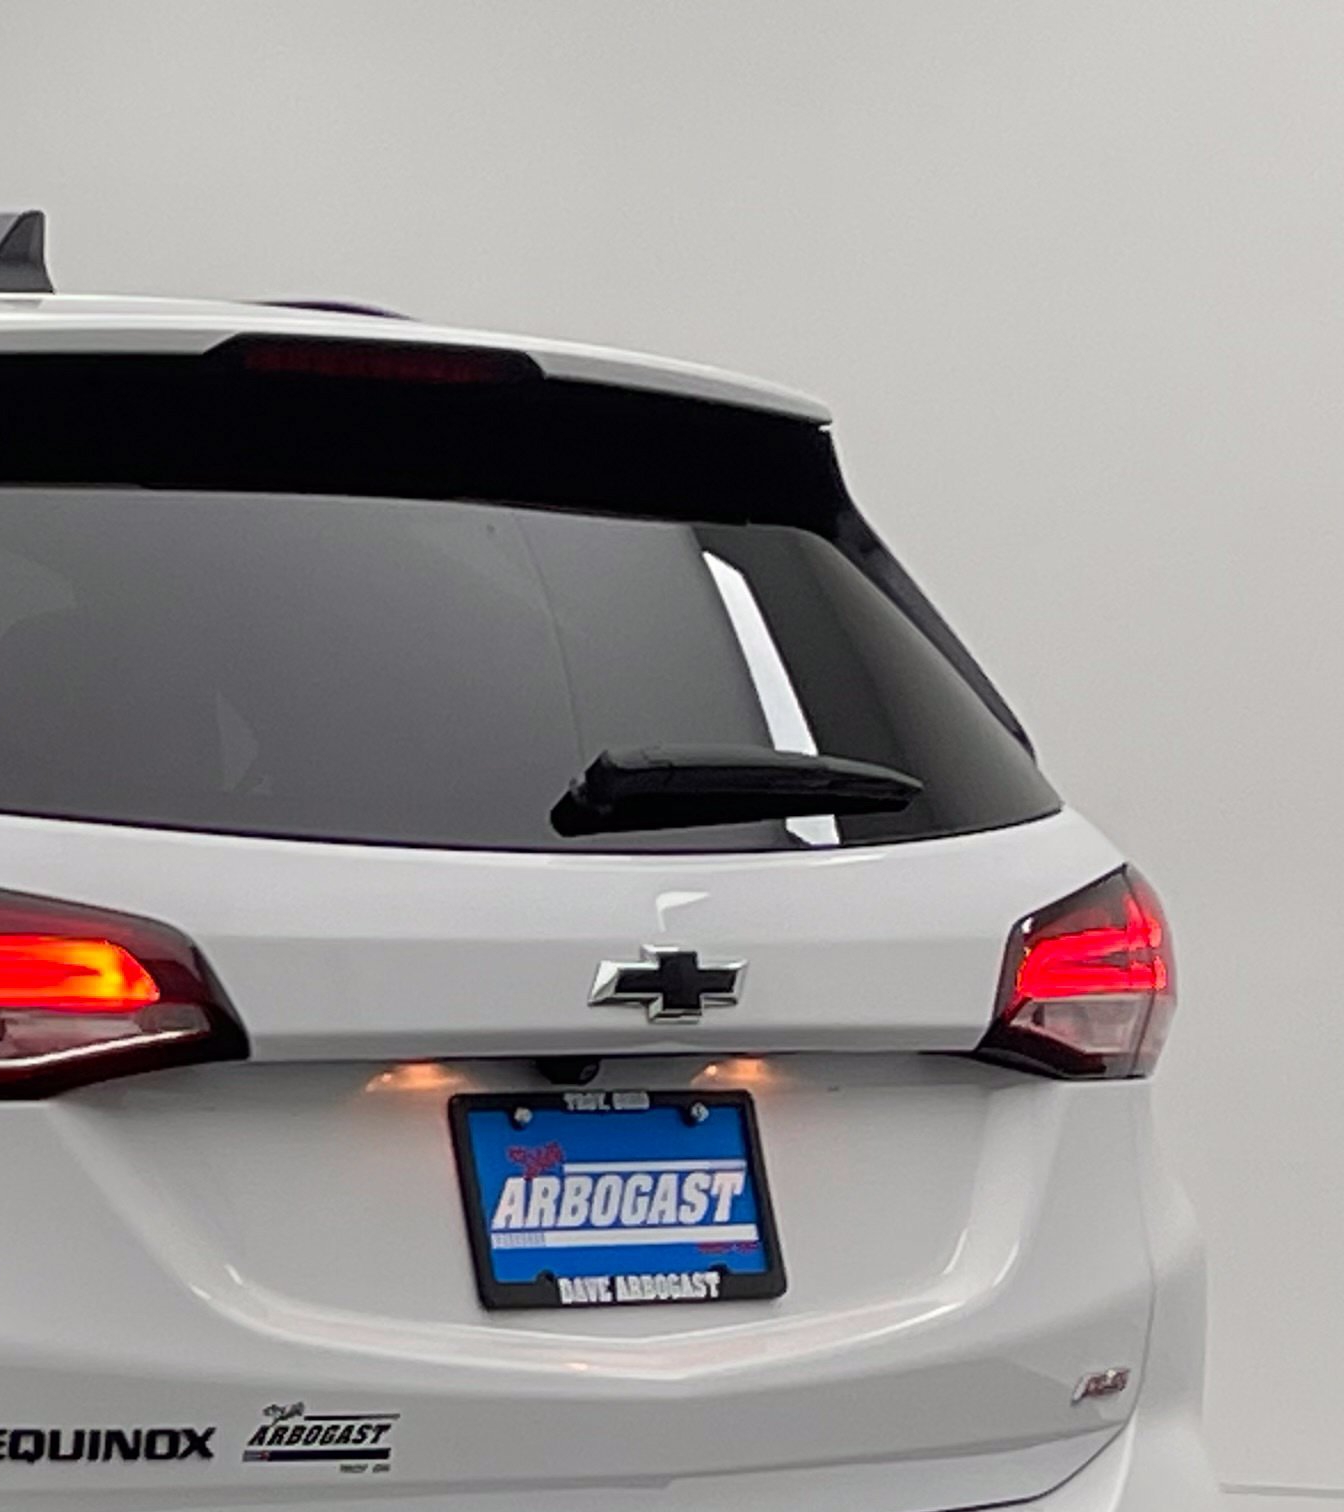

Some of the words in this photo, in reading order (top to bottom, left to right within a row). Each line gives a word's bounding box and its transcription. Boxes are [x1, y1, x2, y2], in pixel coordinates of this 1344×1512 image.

[492, 1170, 746, 1229] ARBOGAST
[558, 1275, 612, 1304] DAVE
[615, 1270, 721, 1302] ARBOGAST
[247, 1423, 392, 1447] ARBOGAST
